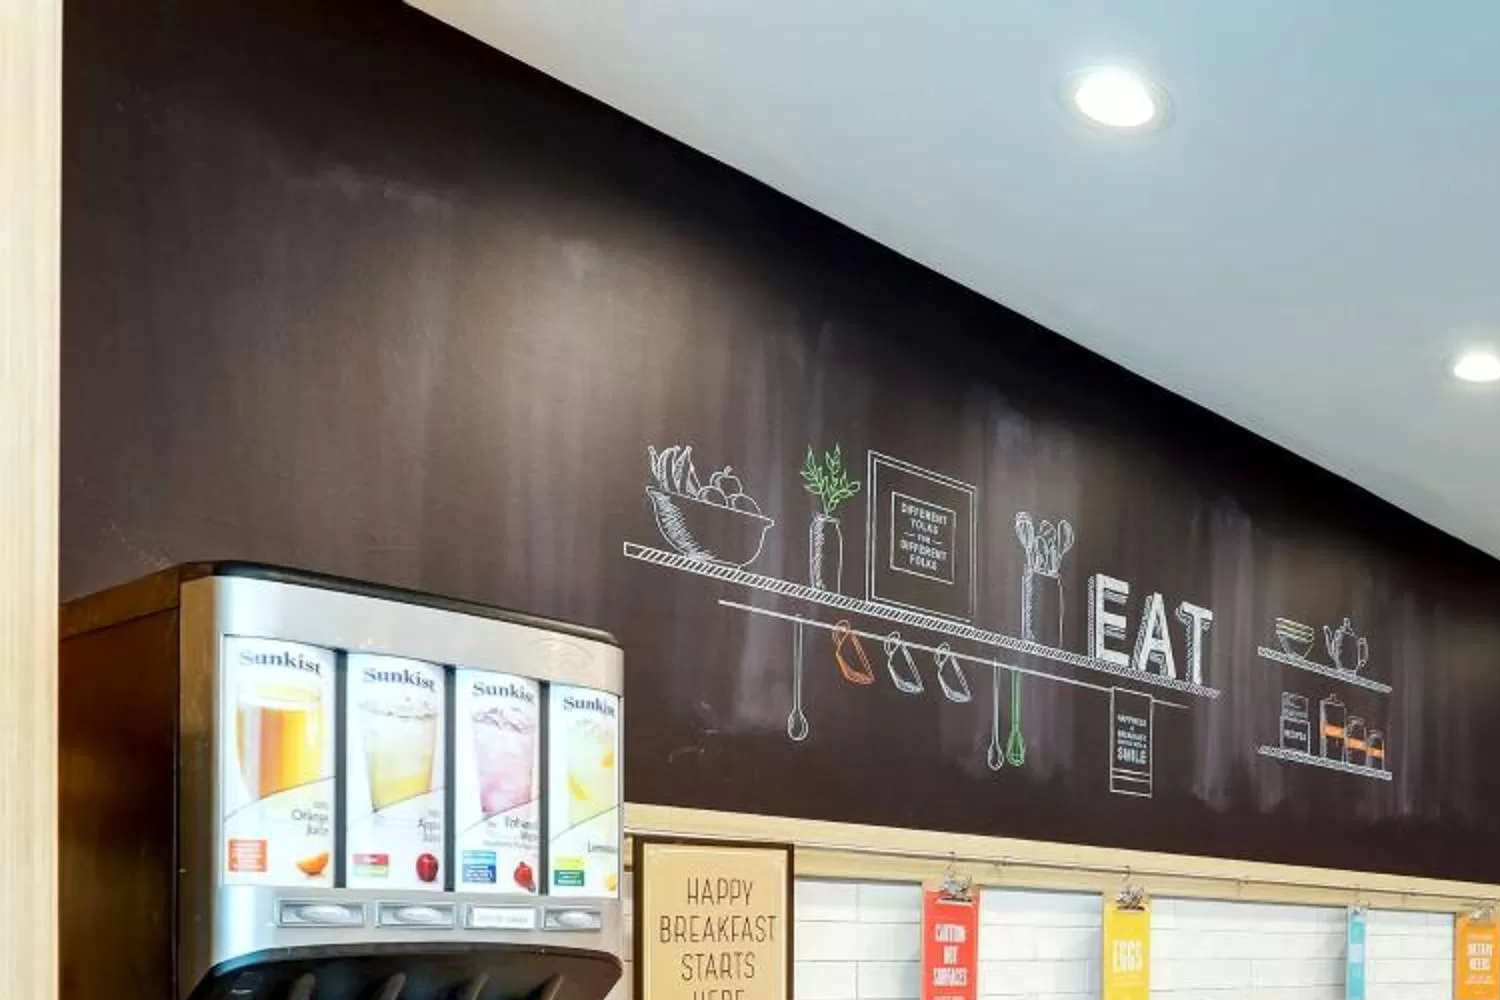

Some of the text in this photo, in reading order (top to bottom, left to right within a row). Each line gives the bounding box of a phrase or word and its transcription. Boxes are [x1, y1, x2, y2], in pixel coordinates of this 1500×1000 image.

[1088, 573, 1213, 685] EAT
[240, 649, 323, 677] Sunkist
[362, 667, 436, 693] Sunkist
[687, 876, 754, 905] HAPPY
[659, 914, 779, 944] BREAKFAST
[680, 951, 756, 981] STARTS
[1112, 939, 1143, 973] EGGS
